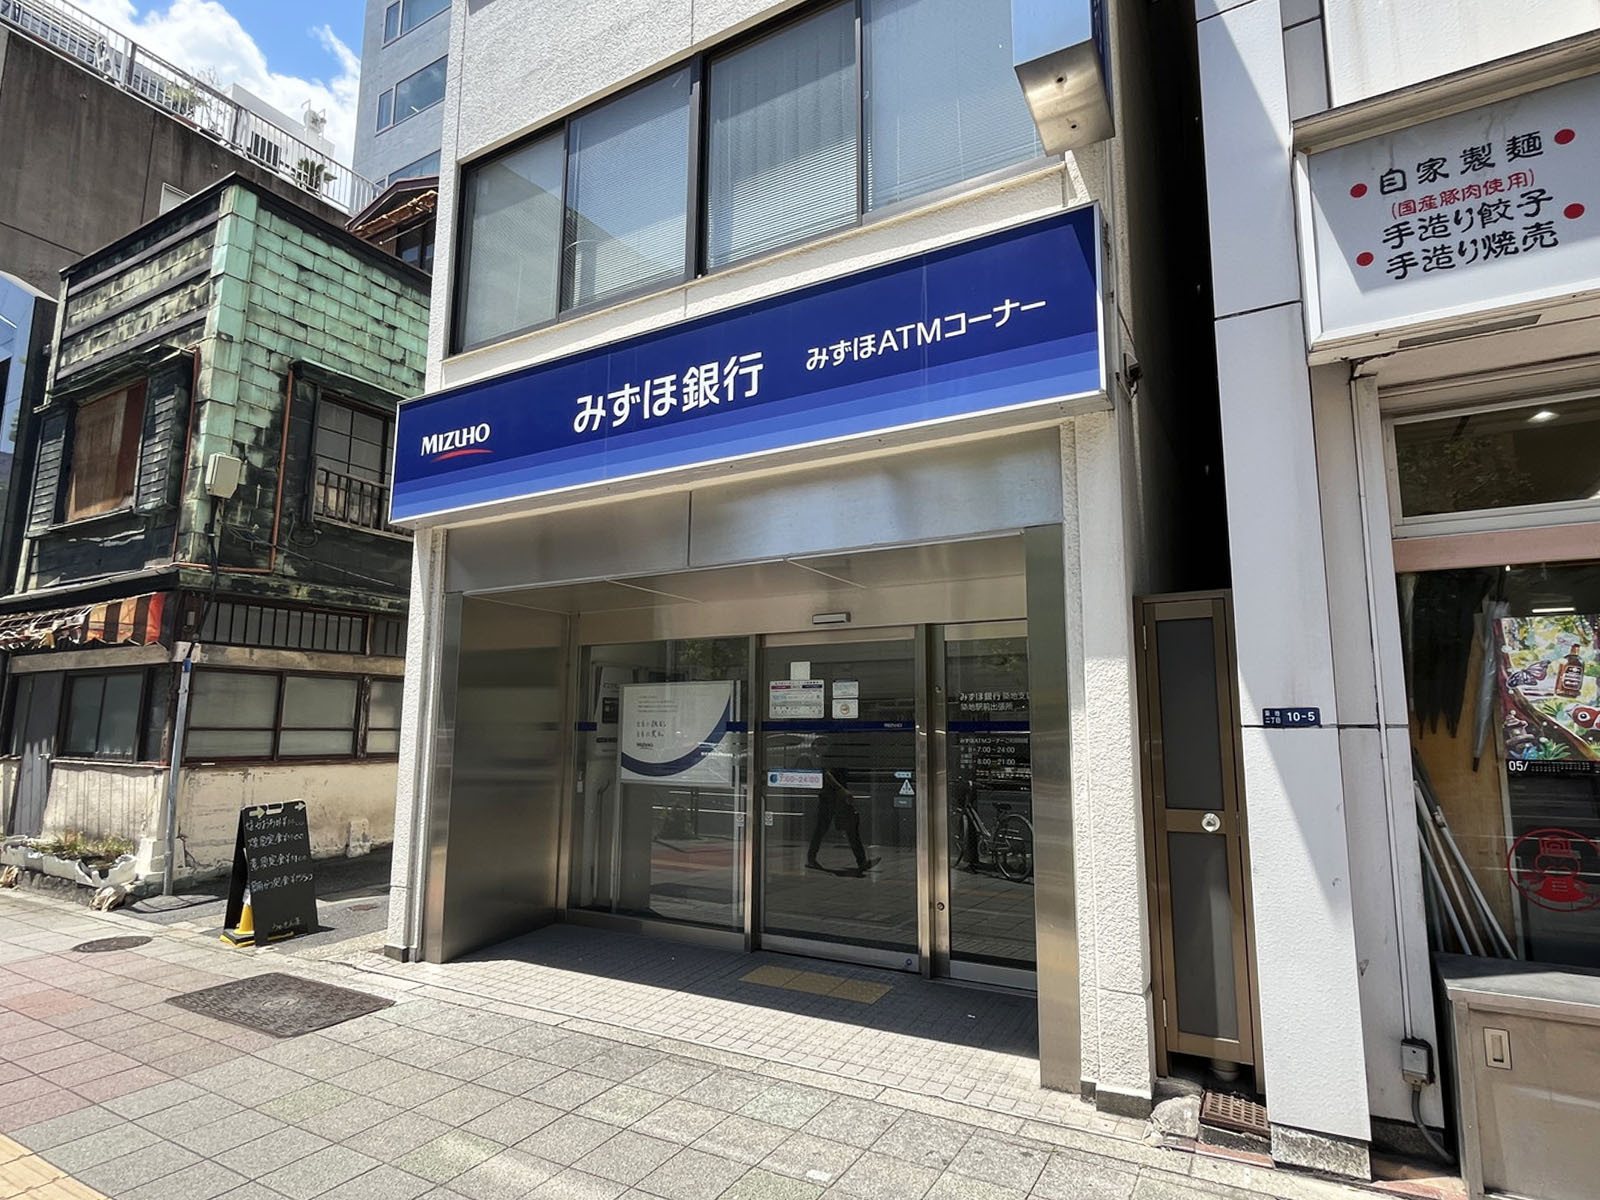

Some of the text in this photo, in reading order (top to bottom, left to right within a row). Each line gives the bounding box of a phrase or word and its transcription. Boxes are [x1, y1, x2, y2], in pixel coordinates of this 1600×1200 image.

[1380, 131, 1544, 195] 自家製麺
[1383, 188, 1553, 249] 手造り餃子
[1391, 169, 1535, 220] (国産豚肉使用)
[1386, 221, 1559, 280] 手造り焼売
[806, 299, 1047, 371] みずほATMコーナー
[573, 351, 764, 434] みずほ銀行
[420, 423, 491, 456] MIZUHO
[1287, 711, 1316, 722] 10-5
[1508, 760, 1529, 772] 05/
